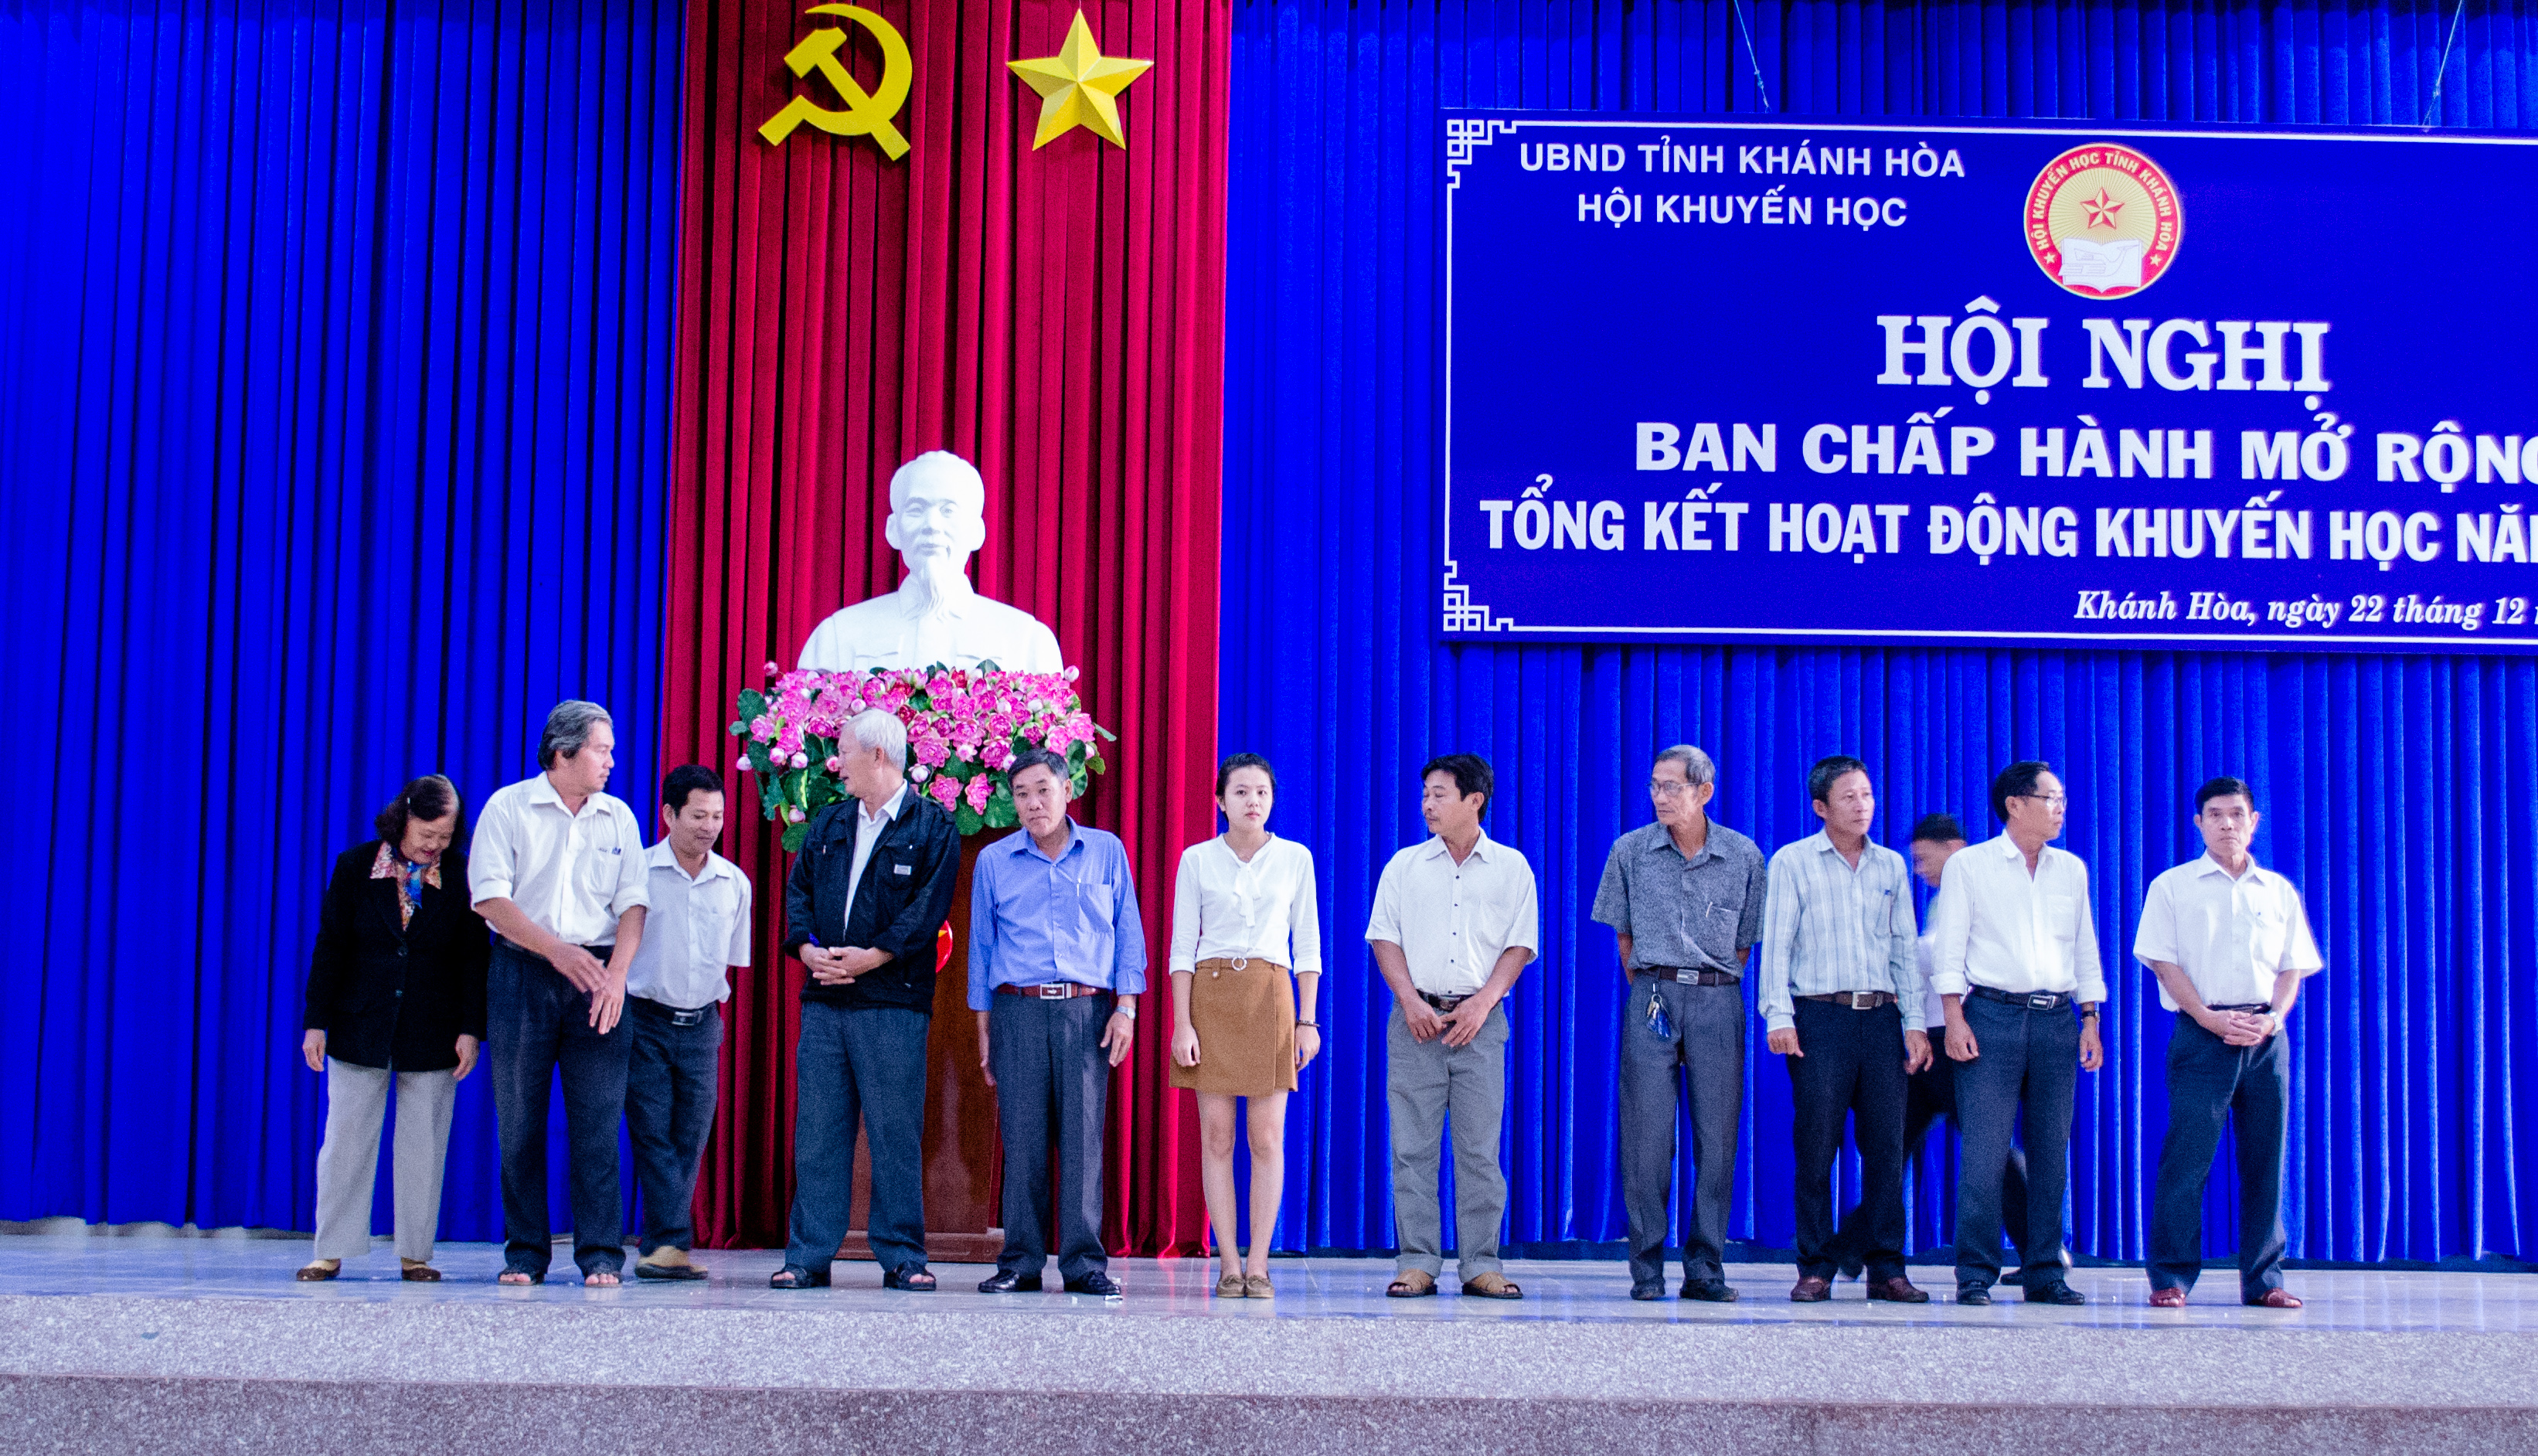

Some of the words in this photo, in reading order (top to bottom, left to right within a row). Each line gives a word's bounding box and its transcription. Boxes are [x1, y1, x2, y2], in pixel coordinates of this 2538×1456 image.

[1519, 142, 1625, 172] UBND
[1638, 134, 1725, 174] TỈNH
[1738, 139, 1872, 176] KHÁNH
[1884, 141, 1966, 178] HÒA
[2069, 152, 2101, 171] HỌC
[2104, 151, 2139, 174] TỈNH
[1578, 186, 1642, 229] HỘI
[1656, 184, 1812, 225] KHUYẾN
[1826, 196, 1907, 232] HỌC
[2032, 165, 2068, 219] KHUYẾN
[2138, 168, 2172, 218] KHÁNH
[2031, 223, 2049, 251] HỘI
[2155, 221, 2174, 252] HÒA
[1876, 295, 2049, 406] HỘI
[2082, 318, 2331, 411] NGHỊ
[1636, 422, 1776, 472] BAN
[1802, 407, 1995, 475] CHẤP
[2020, 414, 2212, 479] HÀNH
[2241, 413, 2353, 481] MỞ
[1479, 473, 1625, 551] TỔNG
[1644, 482, 1749, 551] KẾT
[1768, 502, 1909, 564] HOẠT
[1927, 492, 2078, 566] ĐỘNG
[2095, 490, 2312, 560] KHUYẾN
[2329, 510, 2441, 572] HỌC
[2456, 503, 2538, 563] NĂ
[2074, 590, 2178, 621] Khánh
[2186, 591, 2257, 627] Hòa,
[2268, 594, 2342, 629] ngày
[2349, 594, 2385, 623] 22
[2393, 594, 2484, 631] tháng
[2492, 597, 2526, 625] 12
